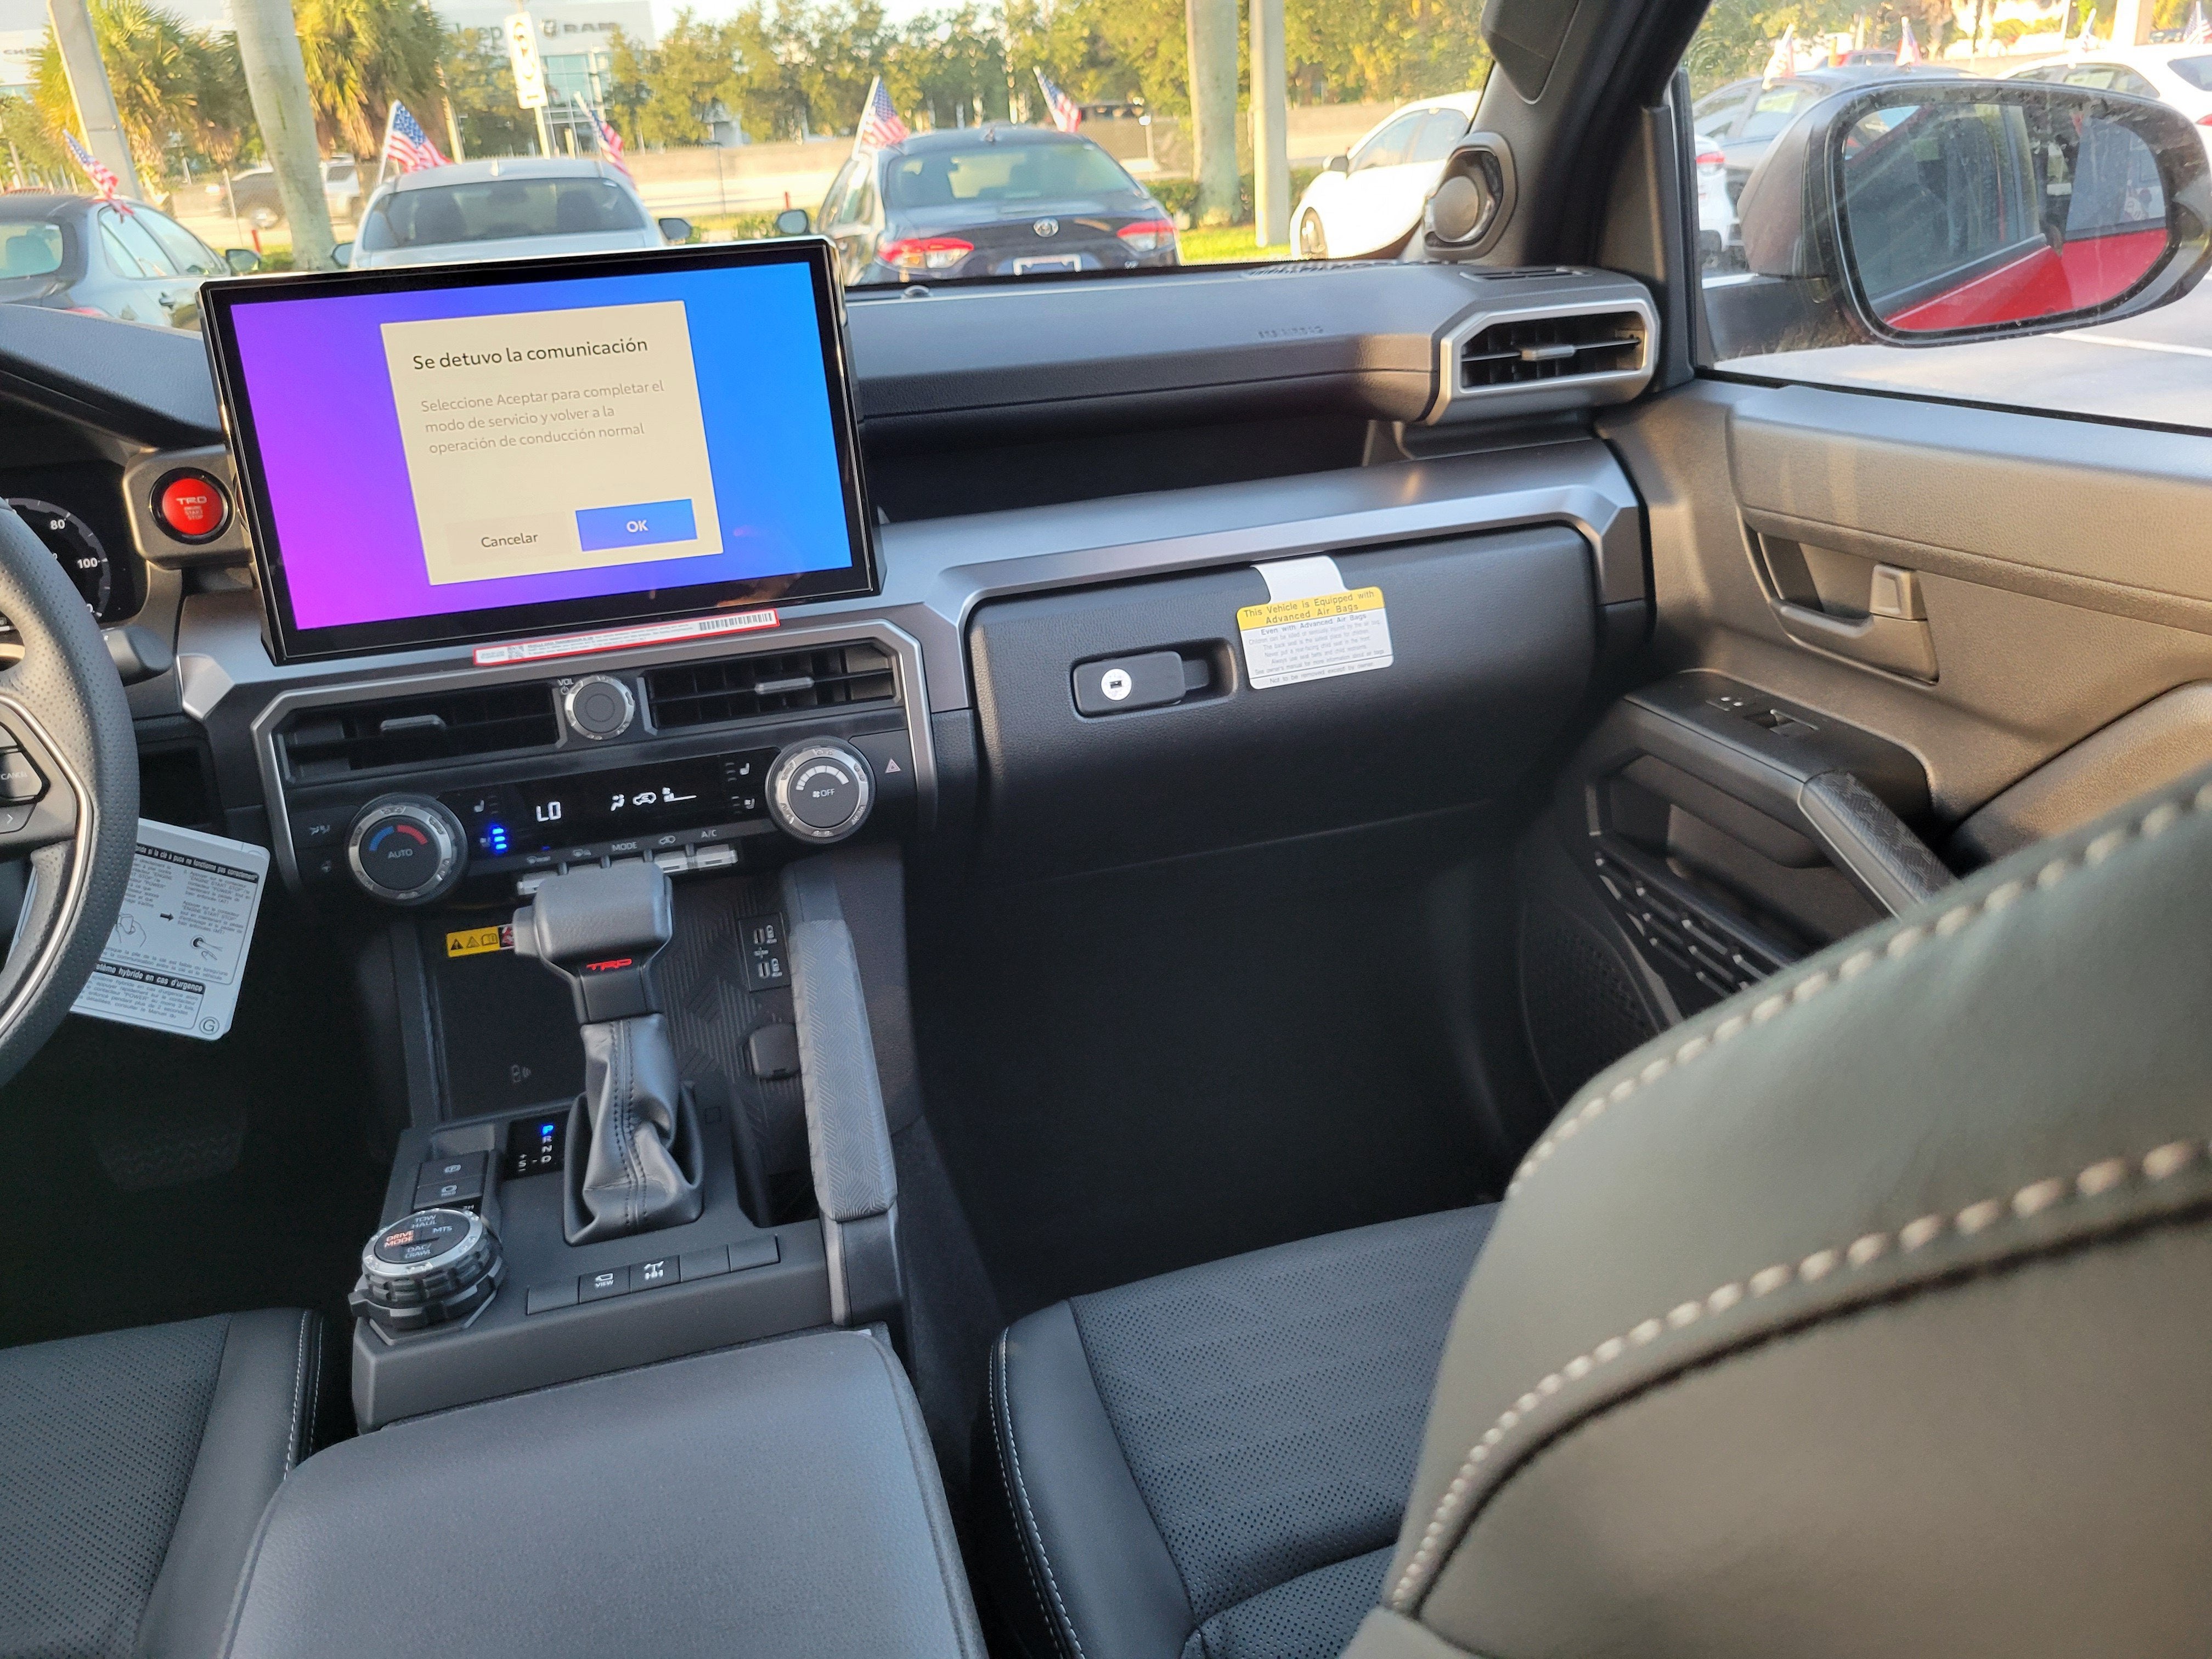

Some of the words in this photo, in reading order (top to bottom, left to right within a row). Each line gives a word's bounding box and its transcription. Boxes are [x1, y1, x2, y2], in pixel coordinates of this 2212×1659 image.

[413, 356, 436, 370] Se
[439, 353, 503, 368] detuvo
[506, 348, 522, 362] la
[527, 337, 648, 360] comunicación
[421, 398, 493, 413] Seleccione
[497, 392, 548, 407] Aceptar
[551, 388, 581, 402] para
[583, 382, 649, 399] completar
[652, 380, 665, 393] el
[426, 418, 465, 432] modo
[468, 416, 486, 429] de
[488, 412, 538, 427] servicio
[541, 413, 548, 425] y
[551, 408, 590, 422] volver
[592, 409, 600, 418] a
[603, 405, 615, 417] la
[429, 437, 496, 455] operación
[499, 435, 516, 447] de
[520, 428, 596, 445] conducción
[599, 423, 645, 438] normal
[176, 496, 207, 505] TRD
[50, 519, 65, 531] 80
[626, 519, 648, 533] OK
[481, 531, 539, 548] Cancelar
[77, 557, 98, 569] 100
[1244, 608, 1262, 618] This
[1267, 603, 1297, 613] Vehicle
[1314, 594, 1353, 607] Equipped
[1357, 590, 1374, 599] with
[1266, 611, 1311, 624] Advanced
[1317, 608, 1330, 616] Air
[1336, 603, 1358, 614] Bags
[1300, 618, 1333, 629] Advanced
[820, 788, 835, 797] OFF
[535, 801, 561, 822] LO
[701, 829, 718, 838] A/C
[611, 842, 637, 851] MODE
[388, 848, 413, 859] AUTO
[586, 958, 632, 971] TRD
[119, 967, 144, 979] hybride
[156, 977, 169, 985] cas
[171, 978, 204, 992] d'urgence
[203, 1019, 216, 1032] G
[542, 1125, 554, 1135] P
[541, 1135, 552, 1144] R
[541, 1144, 552, 1153] N
[518, 1160, 527, 1168] S
[540, 1155, 552, 1163] D
[411, 1220, 437, 1229] HAUL
[415, 1214, 437, 1223] TOW
[385, 1235, 413, 1248] MODE
[386, 1229, 414, 1242] DRIVE
[405, 1250, 431, 1259] CRAWL
[594, 1279, 614, 1288] VIEW
